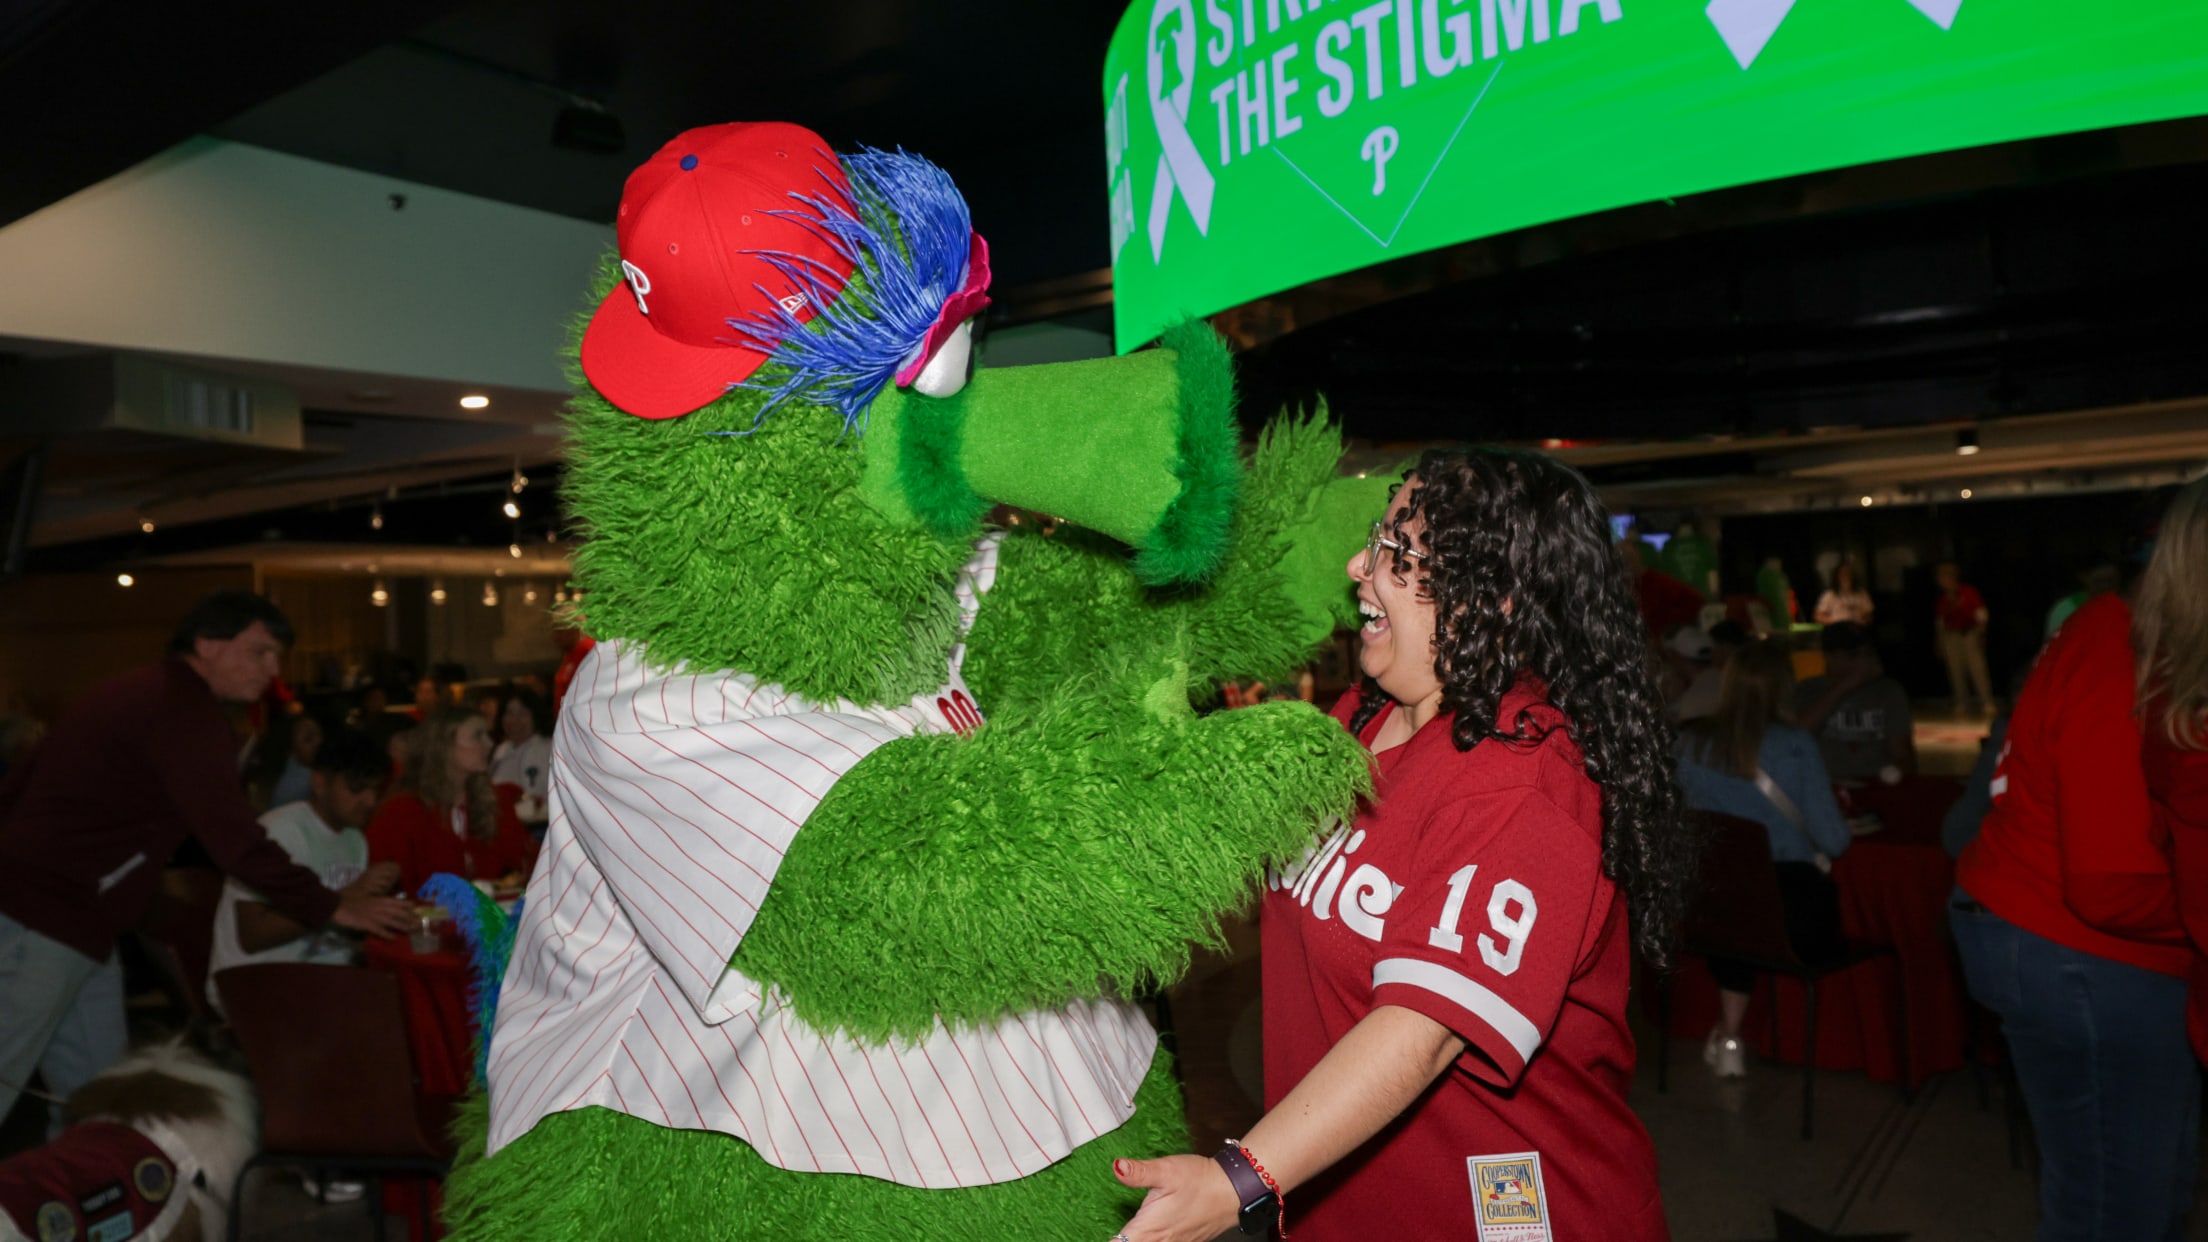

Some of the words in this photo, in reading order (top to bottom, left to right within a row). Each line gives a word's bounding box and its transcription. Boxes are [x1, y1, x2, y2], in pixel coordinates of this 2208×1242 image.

[1210, 42, 1303, 167] THE
[1361, 125, 1400, 196] P
[621, 259, 652, 315] P
[1428, 864, 1539, 976] 19
[1481, 1163, 1533, 1190] COOPERSTOWN
[1486, 1202, 1537, 1220] COLLECTION
